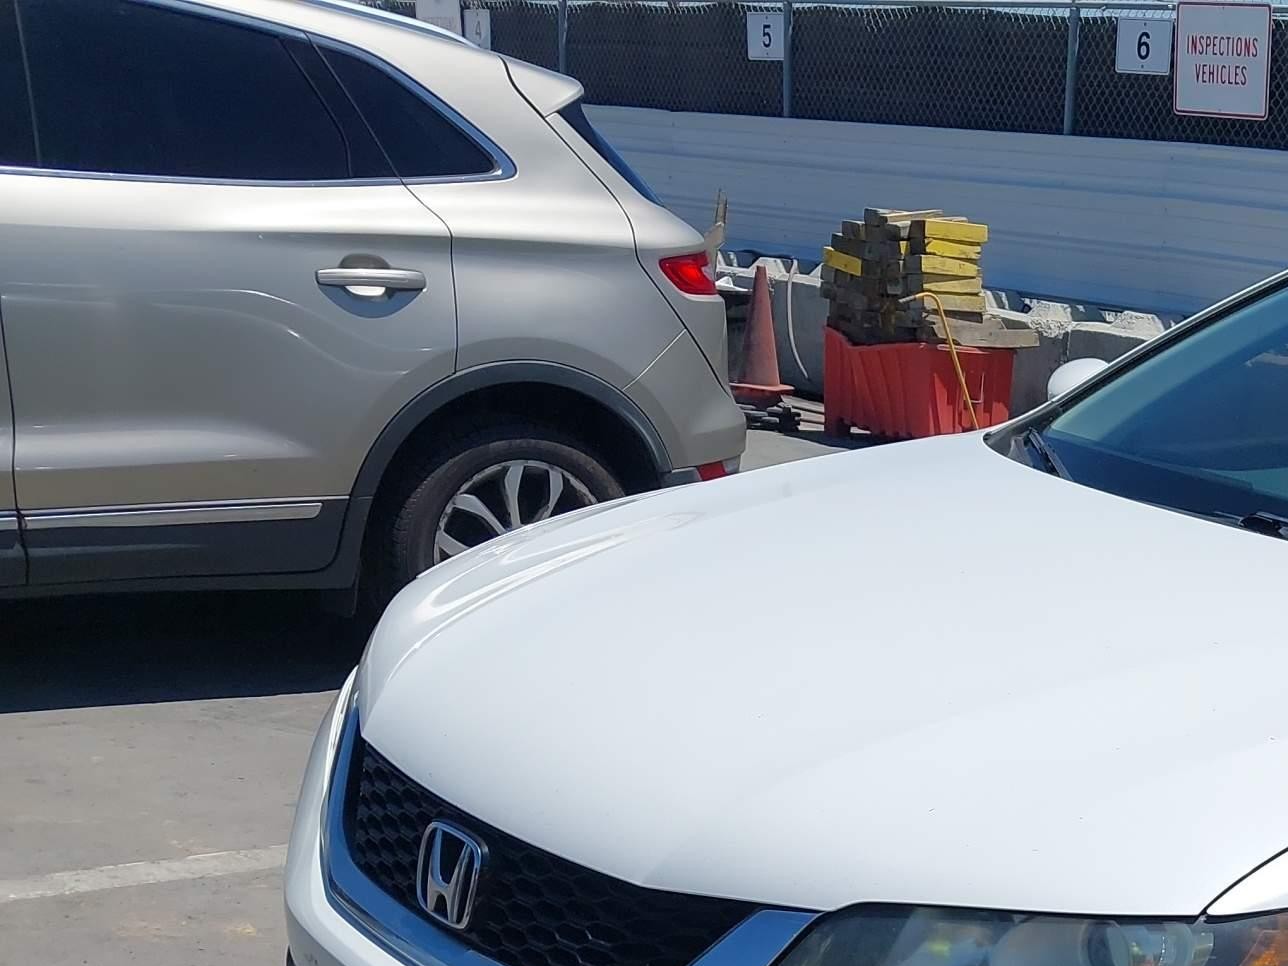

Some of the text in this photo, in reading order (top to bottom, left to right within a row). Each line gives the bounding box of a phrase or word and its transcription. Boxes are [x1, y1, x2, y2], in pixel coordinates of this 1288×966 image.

[762, 24, 772, 48] 5
[1137, 31, 1151, 60] 6
[1186, 34, 1259, 58] INSPECTIONS
[1194, 63, 1248, 86] VEHICLES
